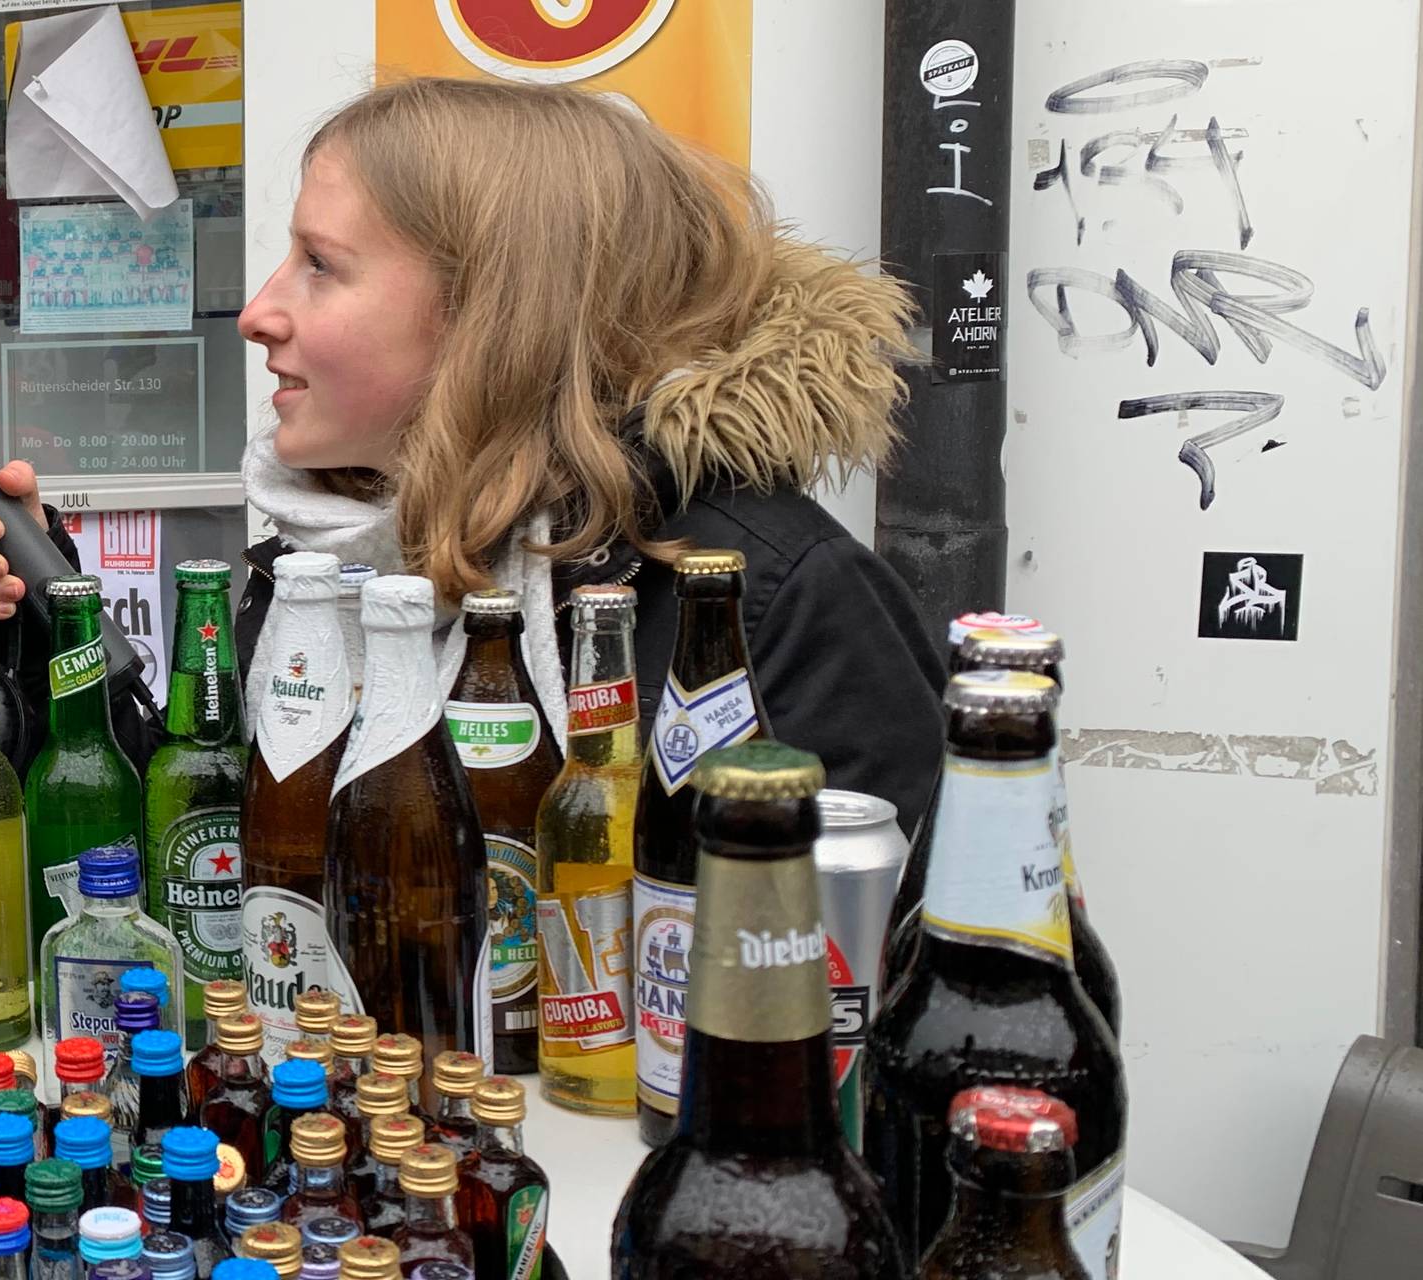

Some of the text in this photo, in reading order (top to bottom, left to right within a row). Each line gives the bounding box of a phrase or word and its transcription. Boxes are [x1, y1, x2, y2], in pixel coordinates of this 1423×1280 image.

[131, 36, 208, 75] HL
[928, 59, 971, 79] SPÄTKAUF
[948, 307, 1001, 323] ATELIER
[952, 326, 997, 342] AHORN
[20, 378, 162, 394] Rüttenscheider Str. 130
[21, 437, 42, 448] Mo
[53, 436, 72, 448] Do
[79, 435, 107, 448] 8.00
[121, 435, 158, 448] 20.00
[161, 434, 186, 447] Uhr
[79, 457, 107, 469] 8.00
[121, 456, 158, 469] 24.00
[161, 455, 186, 468] Uhr
[104, 560, 152, 568] RUHRGEBIET
[55, 643, 104, 680] LEMON
[205, 646, 220, 721] Heineken
[270, 675, 325, 701] Stauder
[704, 696, 744, 724] HANSA
[717, 709, 742, 729] PILS
[459, 722, 509, 737] HELLES
[177, 930, 228, 970] PREMIUM
[737, 922, 825, 970] Diebel
[637, 978, 687, 1020] HAN
[543, 998, 613, 1024] CURUBA
[658, 1021, 685, 1039] PIL
[515, 1221, 542, 1280] MMERLING
